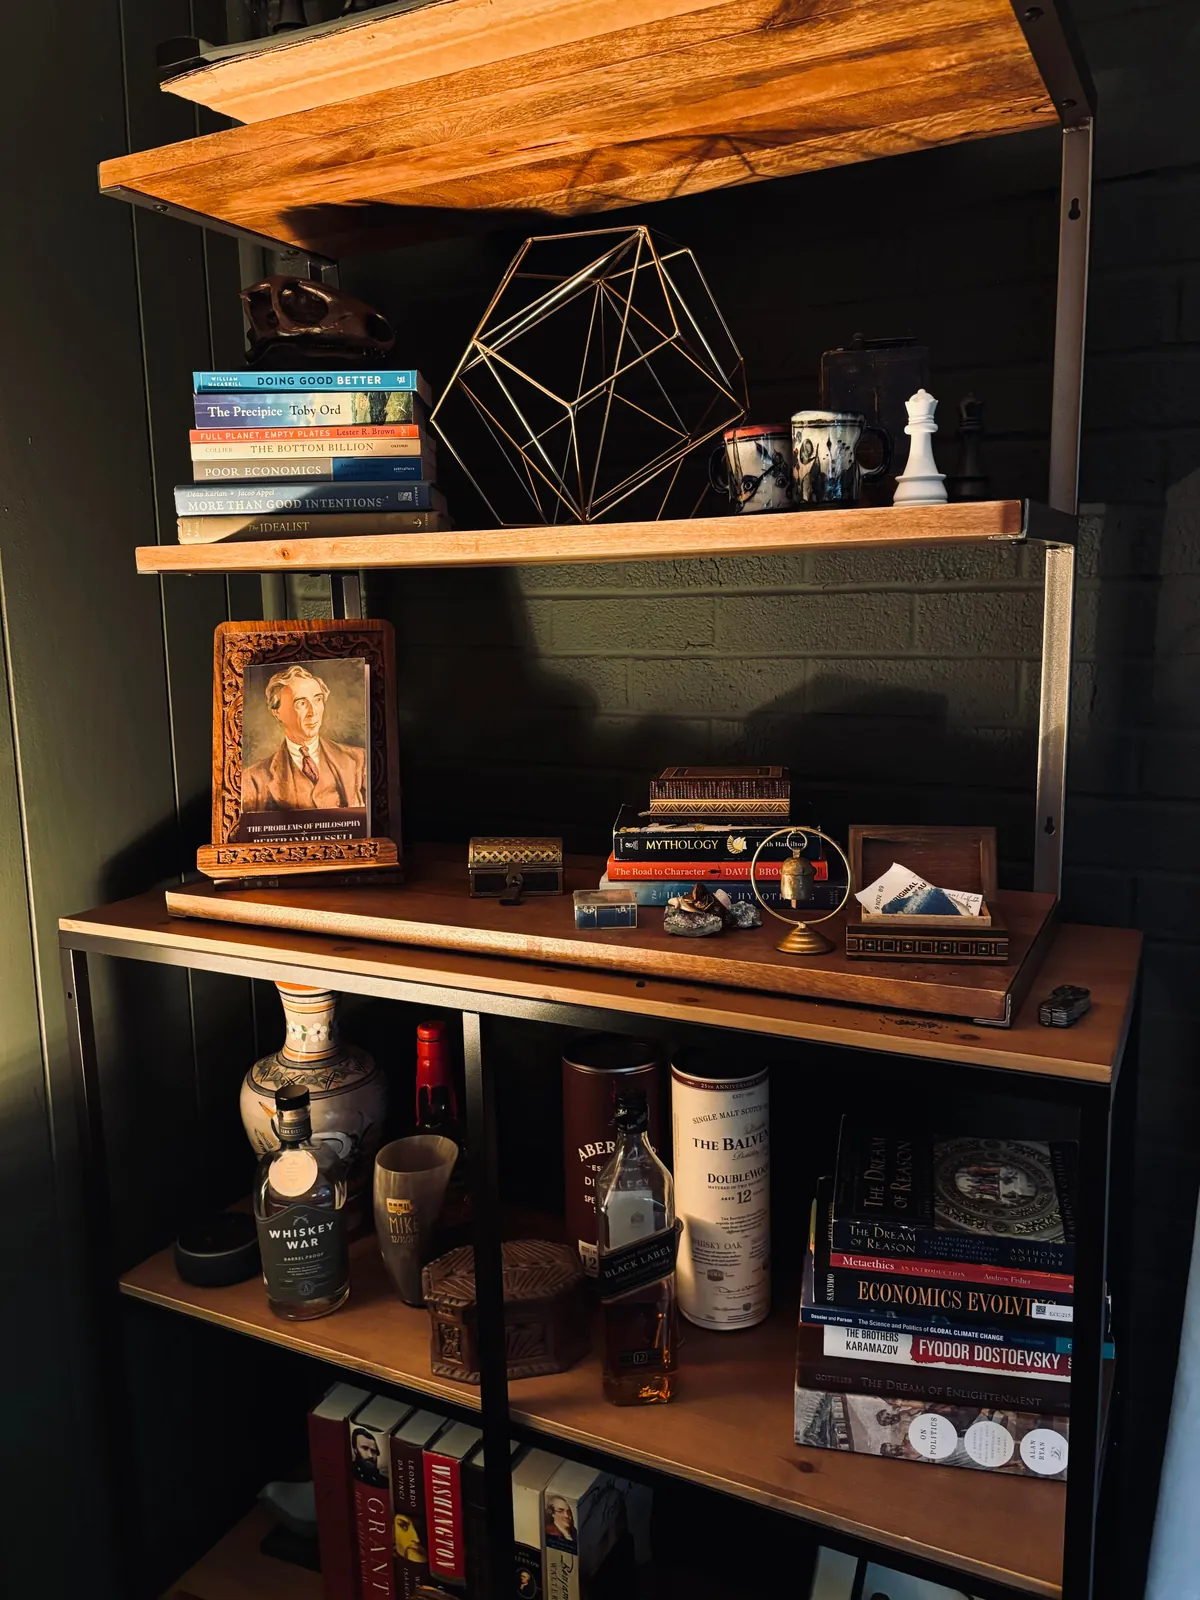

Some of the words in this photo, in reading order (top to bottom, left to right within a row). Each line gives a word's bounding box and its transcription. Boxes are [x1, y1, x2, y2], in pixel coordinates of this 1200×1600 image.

[257, 377, 295, 386] DOING
[299, 376, 334, 385] GOOD
[337, 375, 382, 385] BETTER
[207, 406, 230, 418] The
[233, 406, 283, 419] Precipice
[289, 405, 316, 417] Toby
[320, 404, 341, 415] Ord
[200, 432, 222, 441] FULL
[225, 431, 262, 440] PLANET,
[265, 430, 294, 439] EMPTY
[297, 429, 331, 438] PLATES
[336, 428, 360, 436] Lester
[361, 428, 370, 436] R.
[372, 427, 395, 435] Brown
[250, 445, 274, 454] THE
[277, 444, 324, 453] BOTTOM
[328, 443, 374, 452] BILLION
[205, 467, 240, 477] POOR
[244, 465, 322, 476] ECONOMICS
[187, 501, 225, 511] MORE
[227, 500, 263, 510] THAN
[266, 499, 302, 509] GOOD
[305, 497, 382, 509] INTENTIONS
[260, 521, 310, 533] IDEALIST
[247, 825, 263, 833] THE
[263, 823, 303, 832] PROBLEMS
[303, 822, 314, 830] OF
[314, 820, 361, 829] PHILOSOPHY
[646, 839, 719, 850] MYTHOLOGY
[614, 867, 631, 876] The
[632, 867, 653, 876] Road
[654, 868, 663, 876] to
[664, 867, 706, 876] Character
[725, 868, 753, 876] DAVI
[892, 881, 919, 903] RIGINAL
[693, 1113, 718, 1125] SINGLE
[719, 1109, 740, 1120] MALT
[692, 1137, 719, 1150] THE
[863, 1136, 887, 1182] DREAM
[890, 1140, 912, 1191] REASON
[737, 1189, 752, 1204] 12
[864, 1186, 884, 1207] THE
[894, 1195, 908, 1208] OF
[269, 1221, 334, 1239] WHISKEY
[389, 1216, 420, 1234] MIKE
[849, 1225, 870, 1237] THE
[874, 1226, 916, 1242] DREAM
[286, 1238, 319, 1250] WAR
[724, 1242, 742, 1250] OAK
[850, 1238, 863, 1246] OF
[867, 1237, 916, 1253] REASON
[1010, 1248, 1064, 1258] ANTHONY
[581, 1254, 597, 1270] 12
[604, 1260, 638, 1279] BLACK
[640, 1245, 673, 1265] LABEL
[842, 1255, 895, 1270] Metaethics
[1010, 1255, 1063, 1266] GOTTLIEB
[910, 1266, 965, 1277] INTRODUCTION
[983, 1272, 1010, 1283] Andrew
[826, 1273, 835, 1301] SANDMO
[857, 1281, 962, 1310] ECONOMICS
[845, 1328, 859, 1339] THE
[861, 1329, 899, 1342] BROTHERS
[858, 1318, 868, 1326] The
[869, 1319, 890, 1328] Science
[902, 1323, 923, 1332] Politics
[929, 1326, 953, 1336] GLOBAL
[953, 1329, 979, 1339] CLIMATE
[979, 1333, 1004, 1342] CHANGE
[845, 1341, 899, 1355] KARAMAZOV
[919, 1339, 970, 1360] FYODOR
[974, 1344, 1060, 1370] DOSTOEVSKY
[636, 1353, 645, 1362] 12
[815, 1373, 852, 1384] GOTTLIEB
[860, 1377, 882, 1389] THE
[886, 1379, 925, 1394] DREAM
[928, 1386, 942, 1396] OF
[946, 1387, 1042, 1407] ENLIGHTENMENT
[920, 1429, 927, 1440] ON
[930, 1416, 938, 1455] POLITICS
[397, 1459, 404, 1471] DA
[408, 1459, 417, 1508] LEONARDO
[431, 1464, 456, 1570] WASHINGTON
[366, 1497, 390, 1596] GRANT
